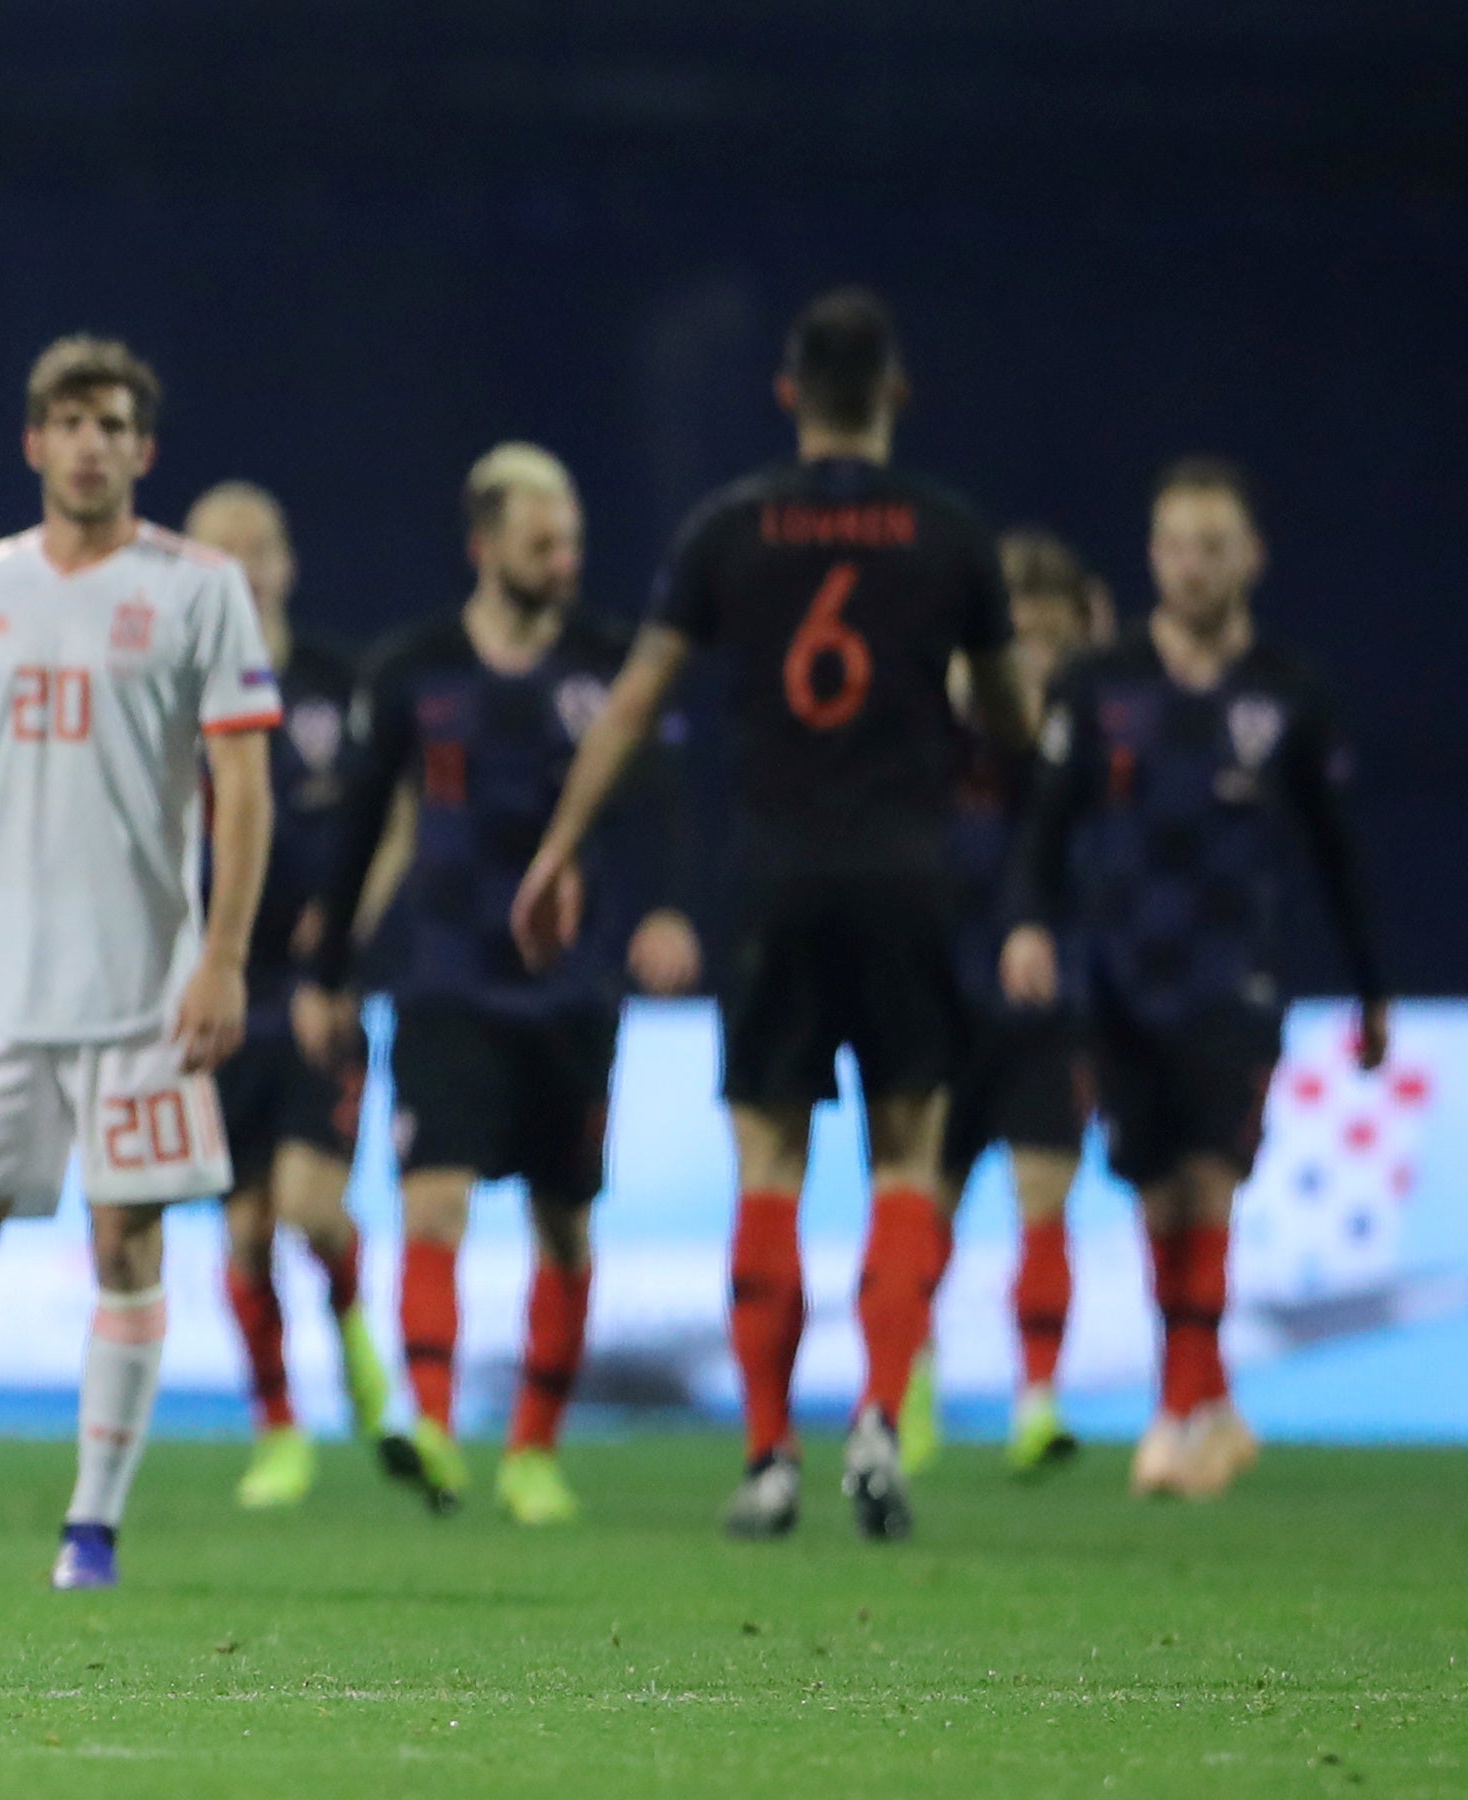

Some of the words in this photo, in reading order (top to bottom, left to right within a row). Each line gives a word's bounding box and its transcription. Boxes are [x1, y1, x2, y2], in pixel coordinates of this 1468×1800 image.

[784, 562, 873, 730] 6
[11, 664, 91, 742] 20
[105, 1089, 191, 1169] 20
